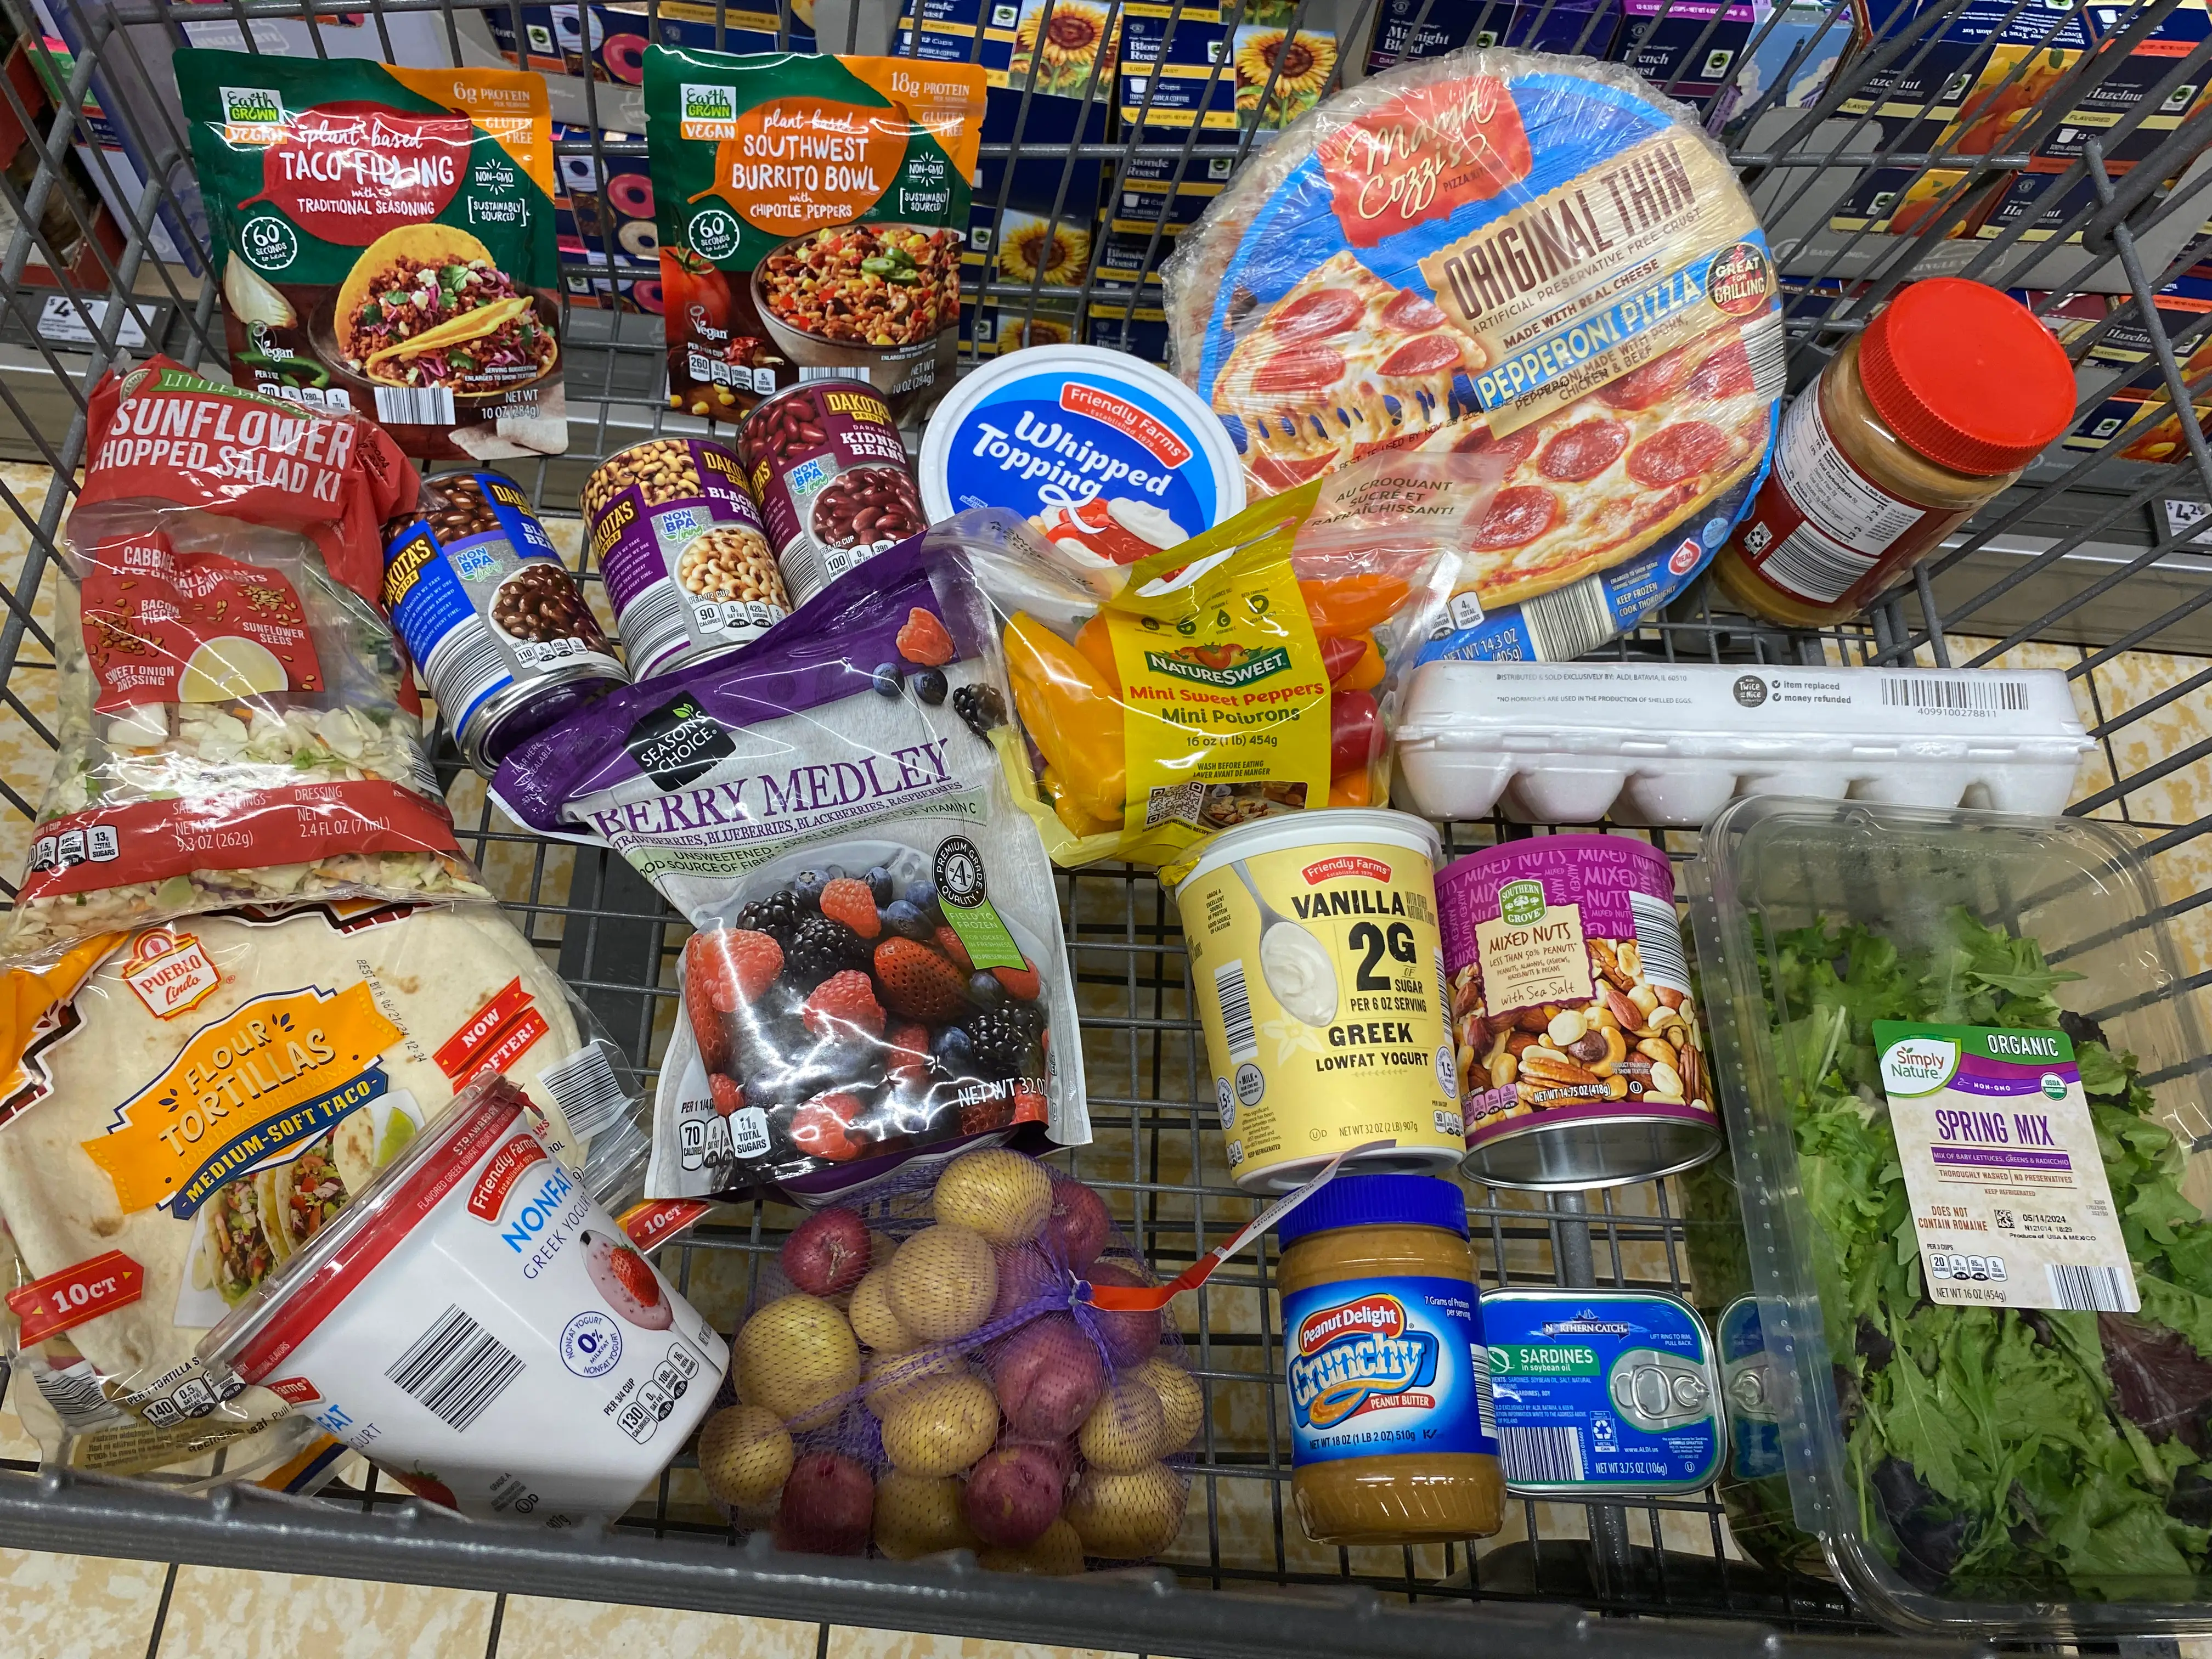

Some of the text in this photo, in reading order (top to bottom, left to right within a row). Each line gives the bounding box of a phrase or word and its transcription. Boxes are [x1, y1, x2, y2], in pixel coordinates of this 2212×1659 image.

[1387, 26, 1449, 46] Minight
[453, 81, 531, 104] 6g PROTEIN
[891, 71, 970, 97] 18g PROTEIN
[2085, 87, 2142, 101] Hazelnu
[227, 91, 275, 108] Earth
[231, 108, 277, 121] GROWN
[486, 117, 533, 130] GLUTEN
[505, 131, 533, 144] FREE
[685, 124, 735, 138] VEGAN
[1344, 84, 1498, 175] Mama
[743, 134, 869, 162] SOUTHWEST
[280, 151, 341, 181] TACO
[475, 171, 514, 184] NON-GMO
[732, 163, 880, 191] BURRITO BOWL
[296, 199, 435, 216] TRADITIONAL SEASONING
[472, 199, 522, 214] SUSTAINABLY
[481, 209, 516, 222] SOURCED
[750, 204, 852, 219] CHIPOTLE PEPPERS
[253, 224, 280, 246] 60
[1443, 143, 1697, 322] ORIGINAL THIN
[255, 242, 287, 255] SECONDS
[1714, 257, 1760, 278] GREAT
[1713, 274, 1767, 304] GRILLING
[1503, 257, 1660, 349] MADE WITH REAL CHEESE
[1477, 269, 1702, 409] PEPPERONI PIZZA
[827, 393, 893, 423] DAKOTA'S
[854, 411, 884, 425] PRIDE
[1070, 387, 1182, 458] Friendly Farms
[1090, 409, 1155, 449] Established 1979
[111, 398, 354, 470] SUNFLOWER
[840, 432, 904, 456] KIDNEY
[851, 444, 906, 464] BEANS
[1014, 410, 1174, 496] Whipped
[219, 447, 308, 494] SALAD
[972, 422, 1108, 534] Topping
[1335, 478, 1453, 503] AU CROQUANT
[1796, 482, 1808, 499] Protein
[1826, 471, 1852, 499] Carbohydrate
[1349, 489, 1426, 507] SUCRÉ ET
[1312, 503, 1454, 527] RAFRAÎCHISSANT!
[677, 524, 704, 542] Lining
[456, 546, 488, 565] NON
[462, 556, 495, 573] BPA
[699, 608, 715, 619] 90
[699, 617, 721, 627] CALORIES
[243, 622, 305, 640] SUNFLOWER
[261, 633, 292, 646] SEEDS
[105, 665, 174, 685] SWEET ONION
[1152, 652, 1286, 686] NATURESWEET
[117, 675, 165, 692] DRESSING
[1804, 682, 1839, 691] replaced
[1130, 682, 1324, 707] Mini Sweet Peppers
[1784, 694, 1851, 703] money refunded
[1162, 707, 1300, 725] Mini Poivrons
[1917, 708, 1997, 718] 4099100278811
[640, 710, 708, 768] SEASON'S
[1249, 735, 1278, 748] 454g
[658, 726, 714, 775] CHOICE
[1197, 760, 1264, 770] WASH BEFORE EATING
[589, 738, 953, 842] BERRY MEDLEY
[707, 782, 962, 845] BLUEBERRIES, BLACKBERRIES, RASPBERRIES
[1307, 859, 1387, 878] Friendly Farms
[1501, 884, 1539, 902] SOUTHERN
[1291, 890, 1406, 921] VANILLA
[1508, 909, 1541, 924] GROVE
[1489, 922, 1571, 953] MIXED NUTS
[139, 955, 202, 994] PUEBLO
[165, 974, 201, 1006] Lindo
[1395, 979, 1424, 995] SUGAR
[1501, 979, 1575, 1006] with Sea Salt
[1395, 996, 1426, 1012] SERVING
[461, 1008, 500, 1049] NOW
[1328, 1023, 1413, 1047] GREEK
[1987, 1034, 2058, 1057] ORGANIC
[184, 1019, 272, 1096] FLOUR
[1316, 1051, 1429, 1072] LOWFAT YOGURT
[1897, 1051, 1944, 1070] Simply
[1891, 1064, 1939, 1079] Nature
[159, 1028, 336, 1158] TORTILLAS
[1973, 1082, 2011, 1091] NON-GMO
[684, 1126, 701, 1140] 70
[1935, 1109, 2055, 1146] SPRING MIX
[185, 1081, 371, 1203] MEDIUM-SOFT TACO
[1939, 1170, 2008, 1180] THOROUGHLY WASHED
[501, 1166, 574, 1254] NONFAT
[2023, 1214, 2066, 1224] 05/14/2024
[523, 1192, 594, 1279] GREEK YOGURT
[1429, 1296, 1469, 1308] Grams Protein
[1304, 1306, 1397, 1348] Peanut Delight
[1521, 1348, 1593, 1363] SARDINES
[1291, 1333, 1422, 1406] Crunchy
[1530, 1363, 1556, 1372] soybean
[147, 1401, 172, 1418] 140
[1370, 1396, 1429, 1408] PEANUT BUTTER
[621, 1406, 645, 1430] 130
[1620, 1462, 1667, 1475] 3.75 (106g)
